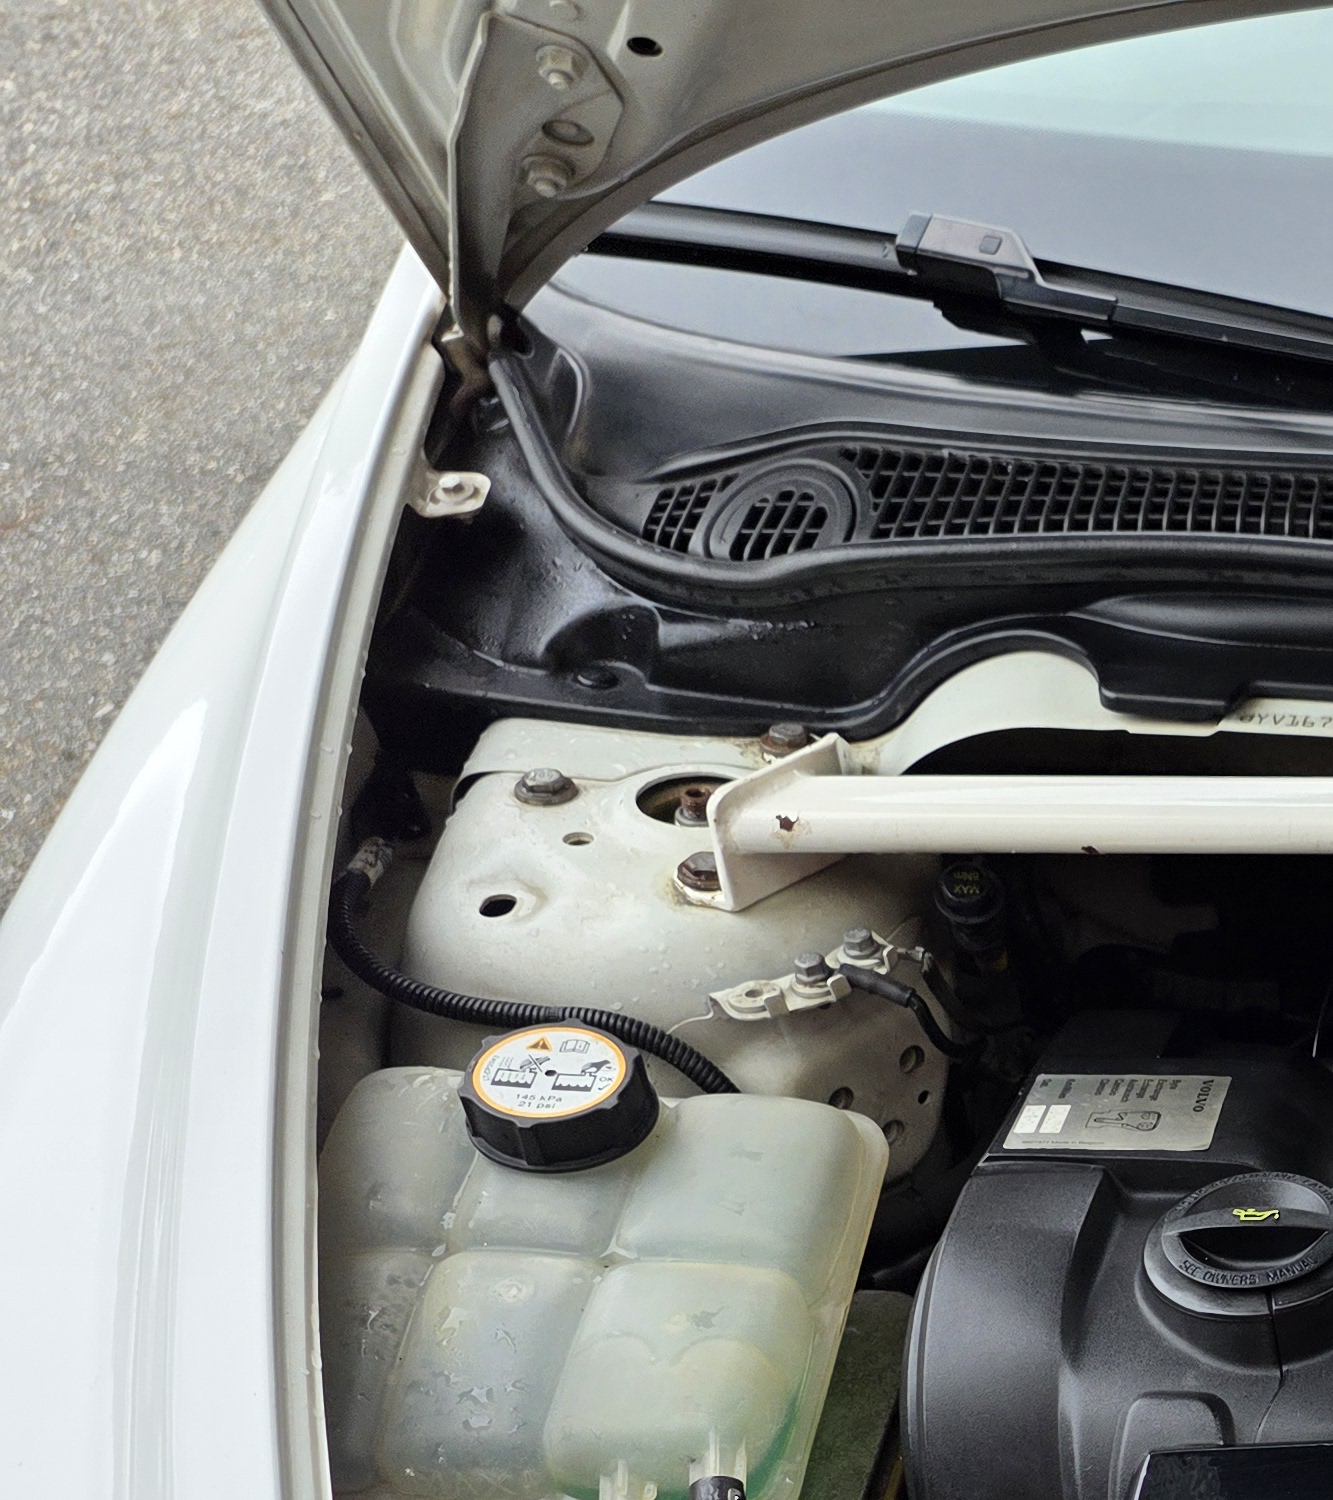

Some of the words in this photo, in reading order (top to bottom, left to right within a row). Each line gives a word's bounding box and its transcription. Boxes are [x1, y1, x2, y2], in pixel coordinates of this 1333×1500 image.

[515, 1093, 536, 1101] 145
[539, 1094, 563, 1102] kPa
[1192, 1078, 1215, 1113] VOLVO
[1179, 1259, 1200, 1276] SEE
[1202, 1270, 1259, 1286] OWNERS
[1266, 1256, 1318, 1283] MANUAL
